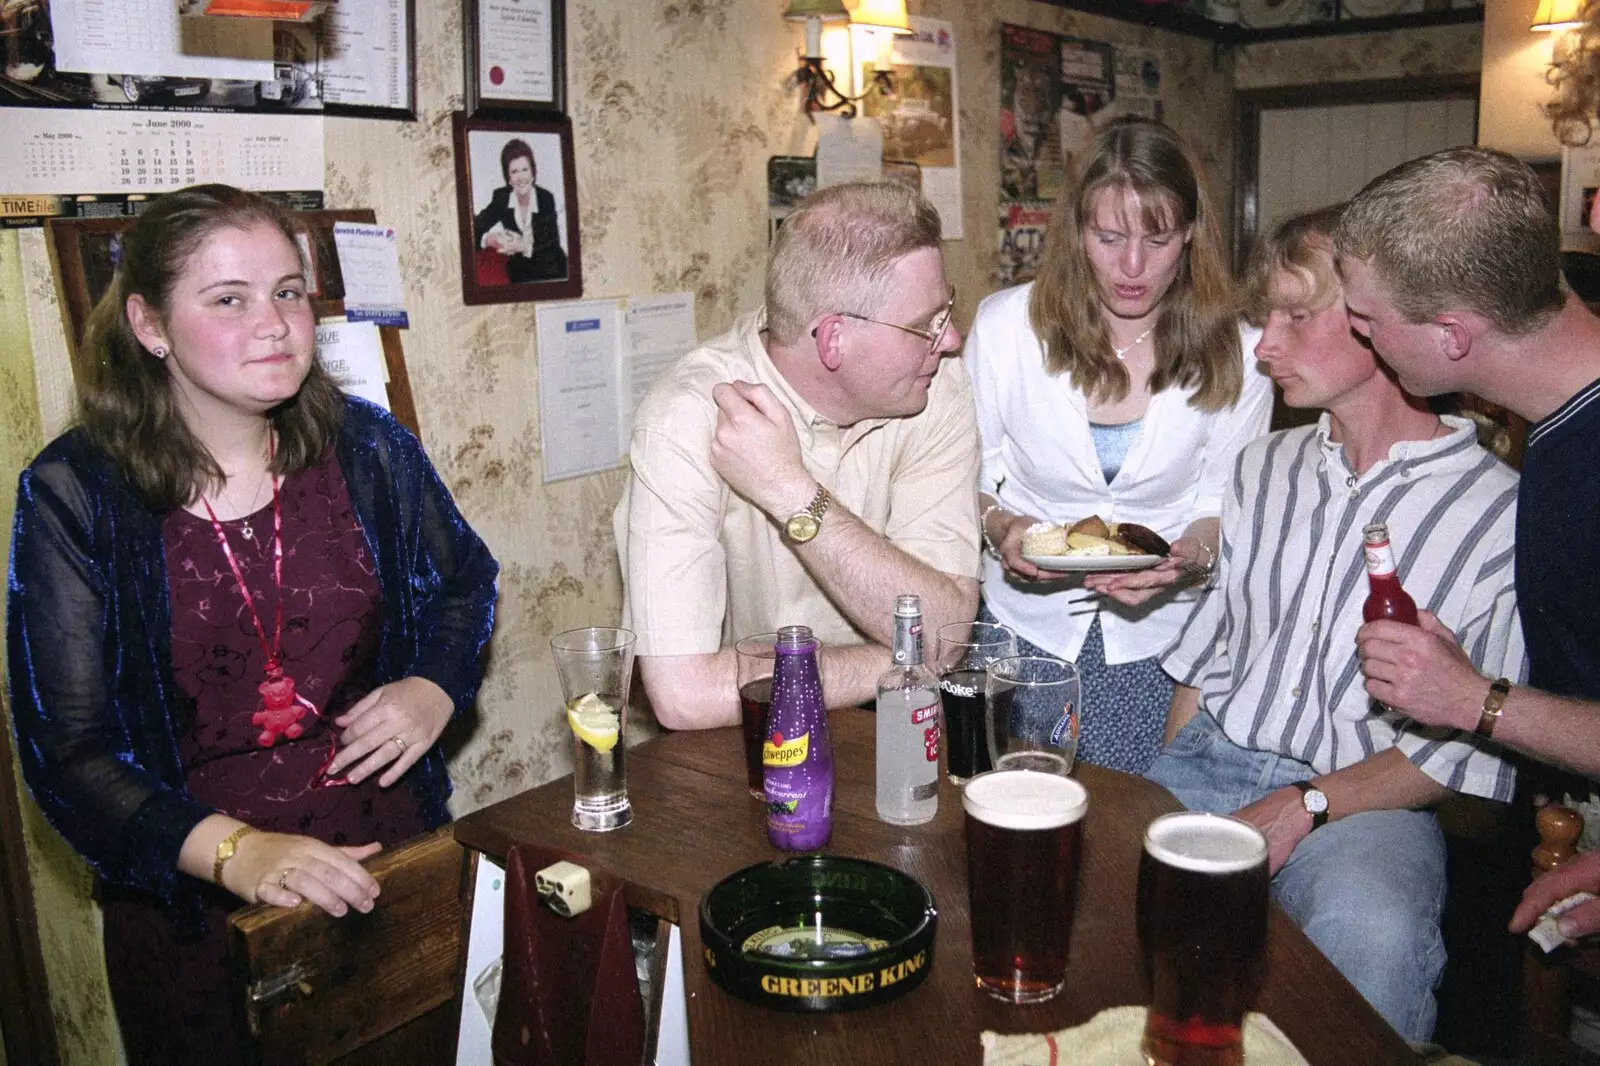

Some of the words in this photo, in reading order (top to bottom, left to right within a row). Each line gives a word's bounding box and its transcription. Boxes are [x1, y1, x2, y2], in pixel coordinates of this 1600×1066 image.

[146, 119, 168, 128] June
[170, 120, 191, 128] 2000
[43, 132, 55, 140] May
[945, 680, 974, 697] Coke
[761, 974, 875, 998] GREENE
[879, 950, 926, 987] KING
